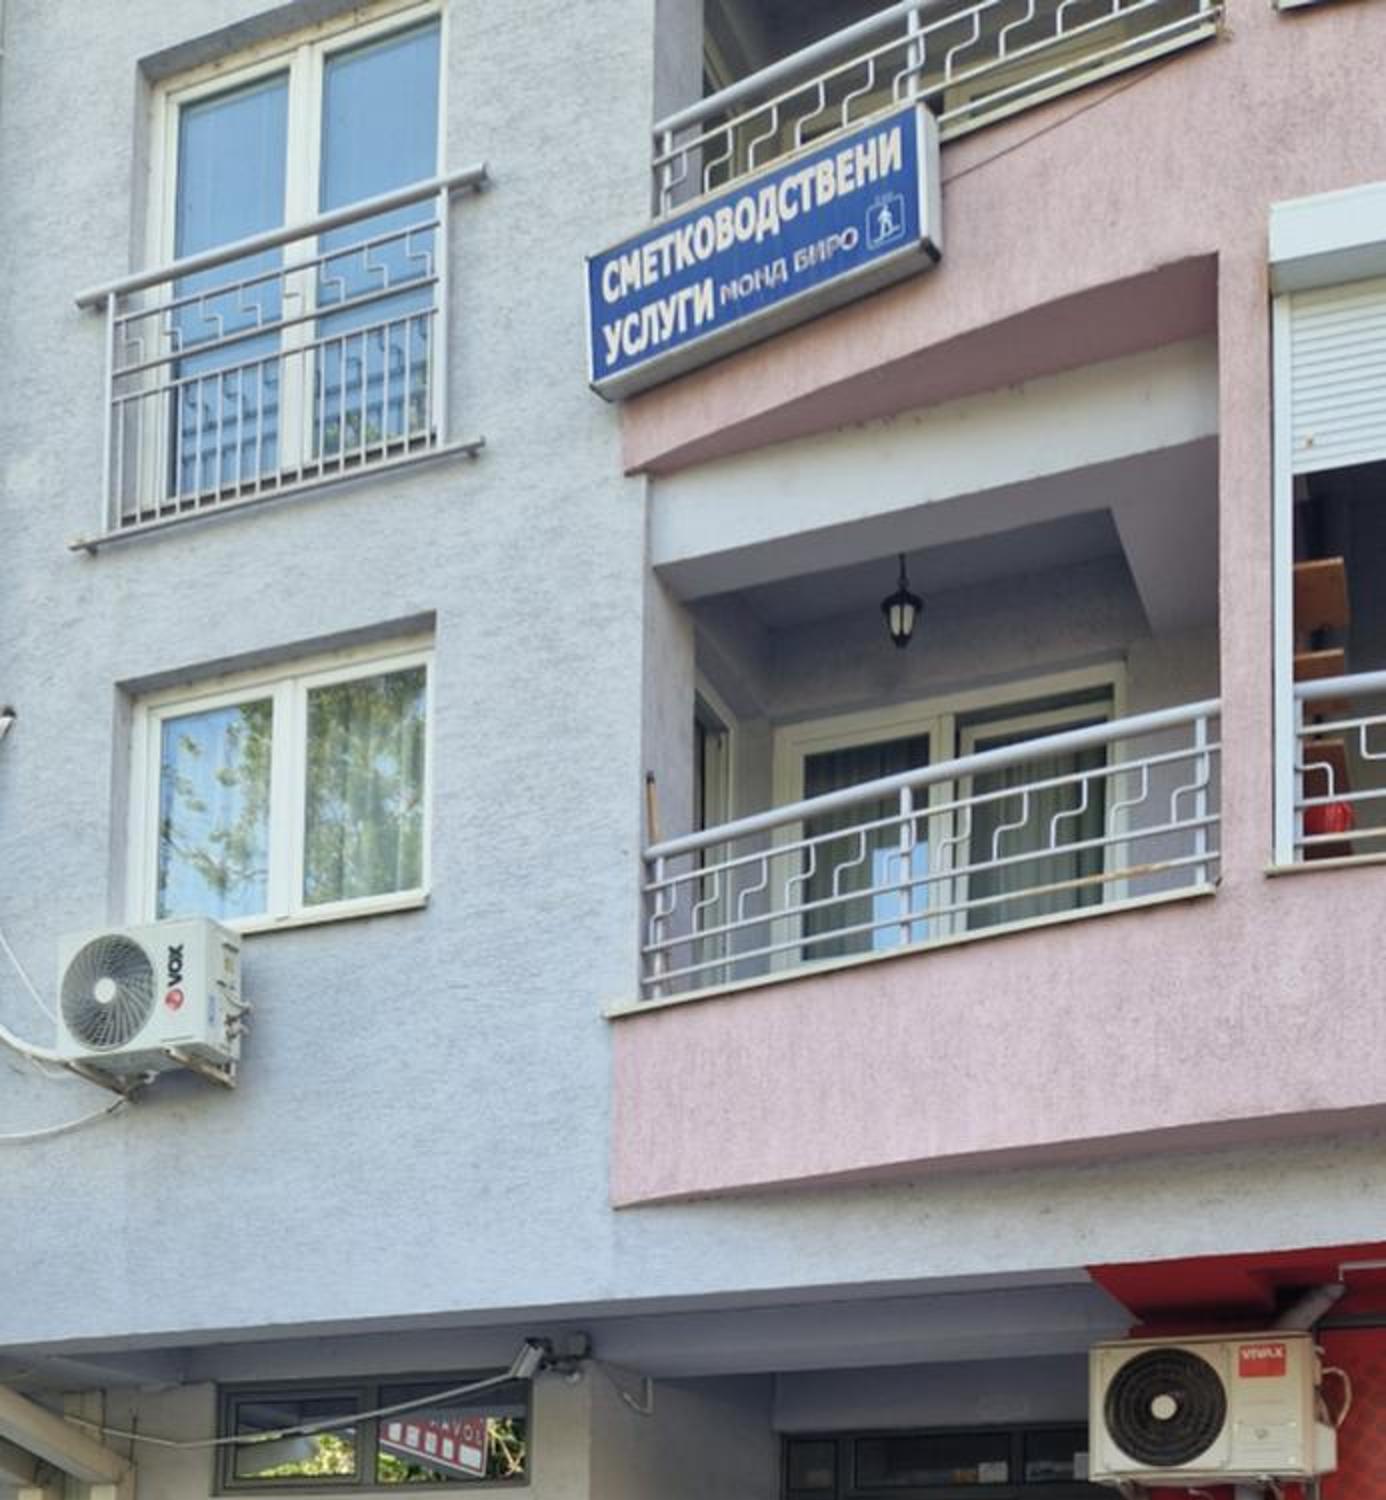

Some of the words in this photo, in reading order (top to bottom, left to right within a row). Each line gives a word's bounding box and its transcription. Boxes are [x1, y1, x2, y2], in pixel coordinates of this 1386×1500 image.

[602, 126, 902, 303] СМЕТКОВОДСТВЕНИ
[602, 277, 715, 366] УСЛУГИ
[720, 258, 789, 305] МОНД
[793, 226, 859, 273] БИРО
[167, 944, 184, 987] VOX
